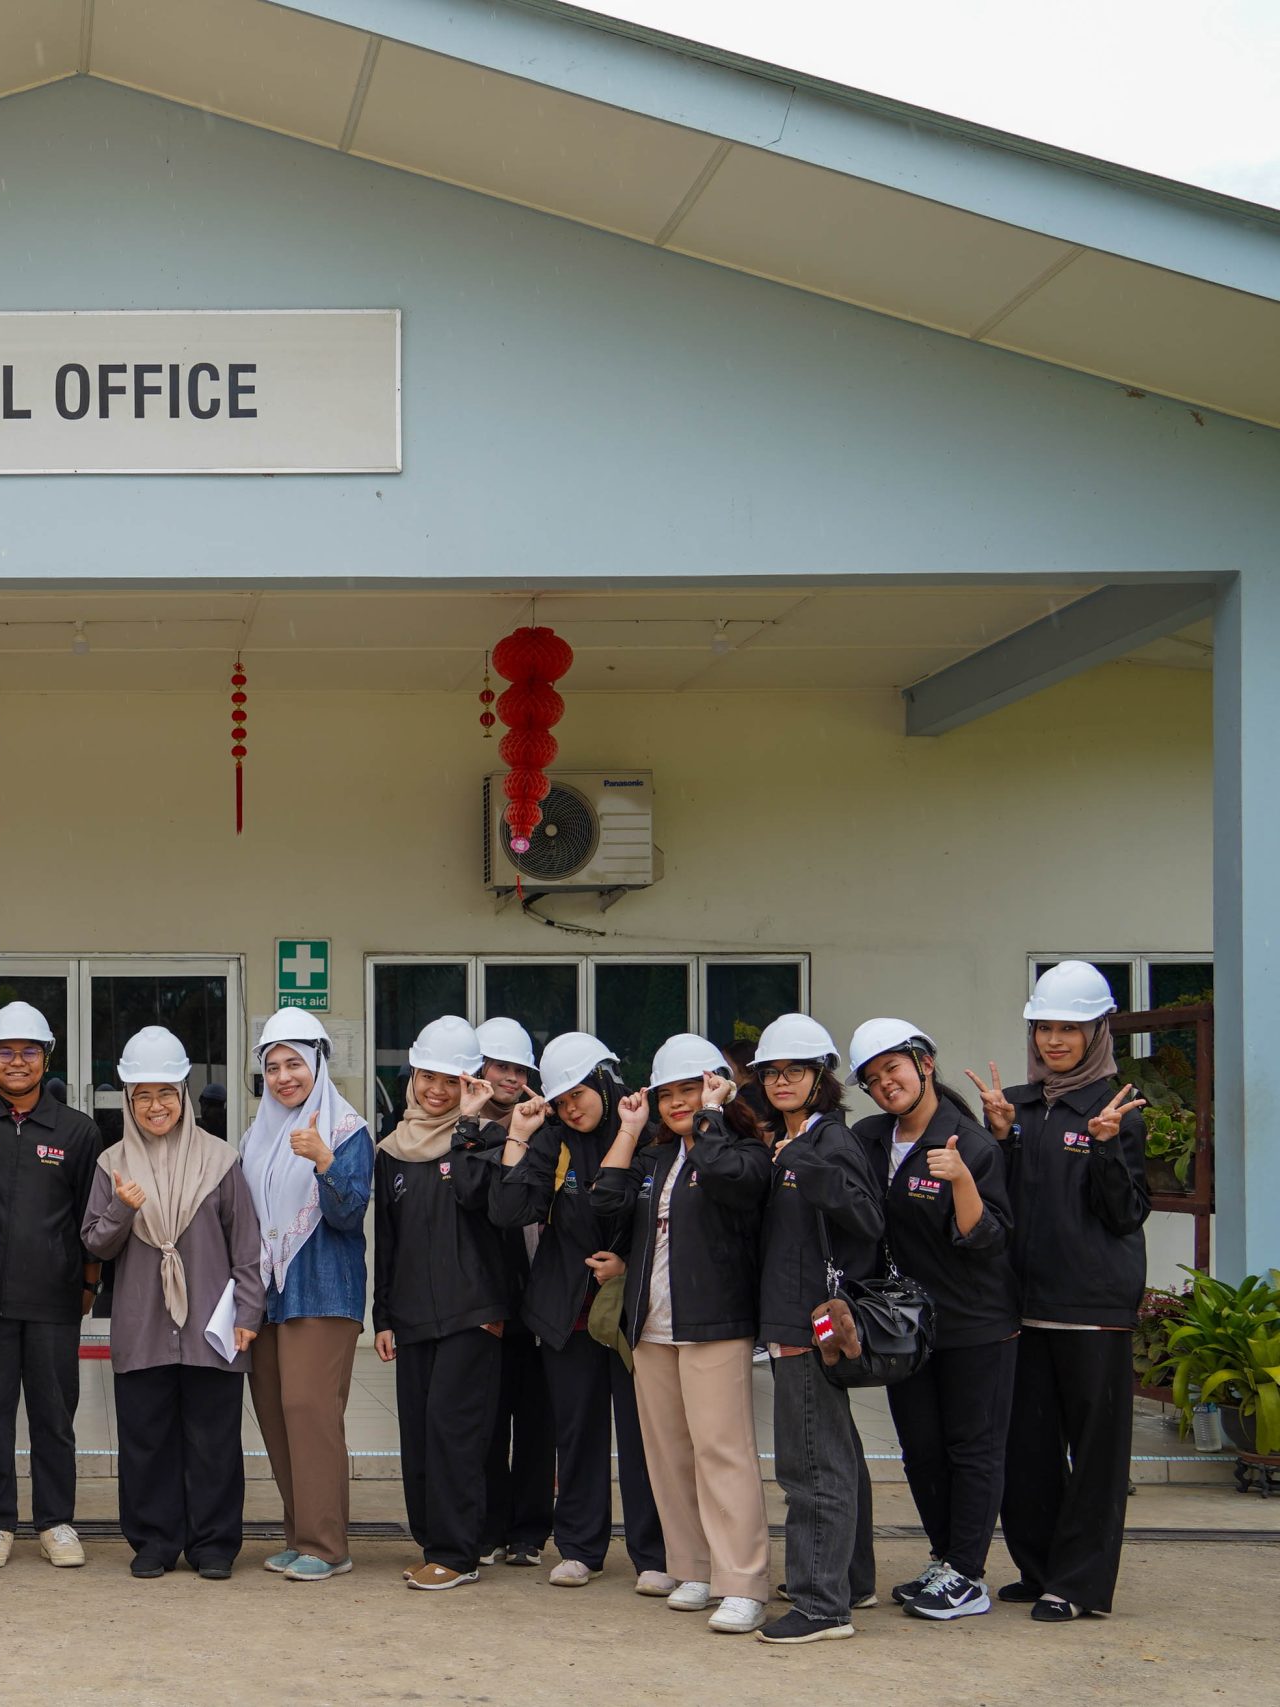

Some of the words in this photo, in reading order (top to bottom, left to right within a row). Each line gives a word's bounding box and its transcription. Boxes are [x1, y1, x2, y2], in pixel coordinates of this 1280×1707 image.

[54, 362, 258, 420] OFFICE
[603, 779, 643, 788] Panasonic
[280, 995, 307, 1007] First
[309, 996, 327, 1006] aid
[920, 1179, 941, 1189] UPM
